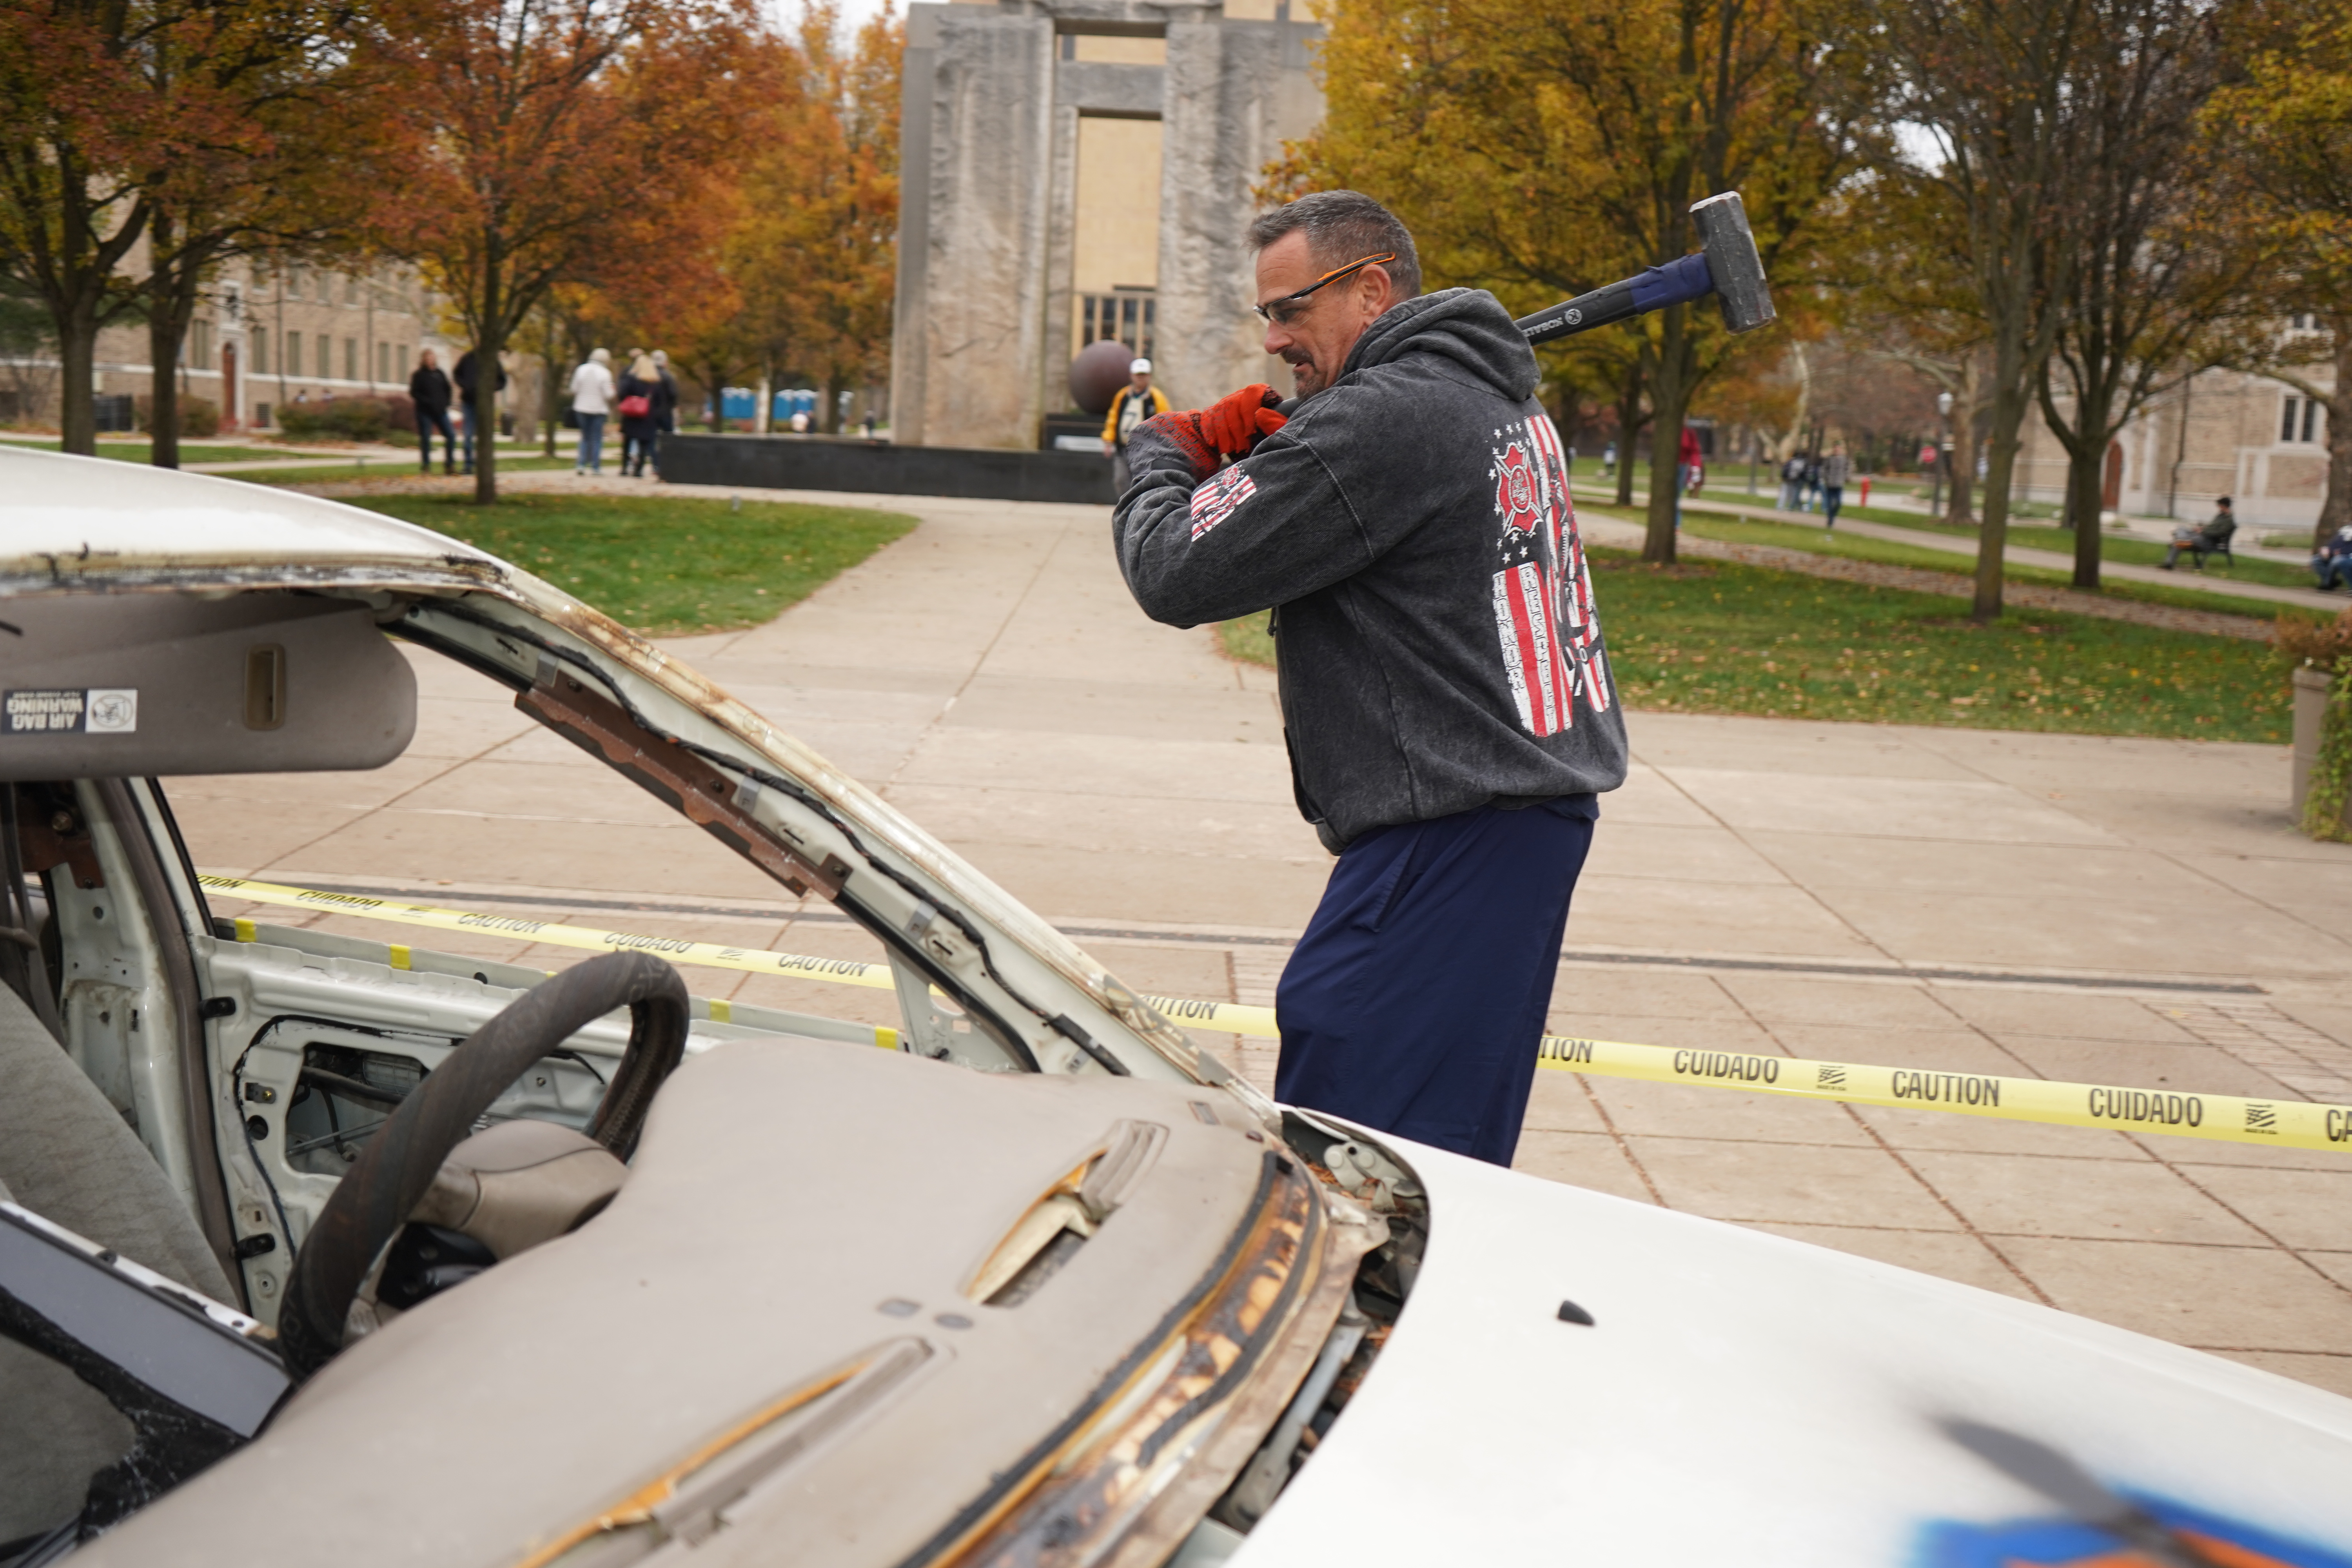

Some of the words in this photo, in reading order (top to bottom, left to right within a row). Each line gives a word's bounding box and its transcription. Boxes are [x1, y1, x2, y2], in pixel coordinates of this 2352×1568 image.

[196, 875, 246, 890] TION
[297, 891, 383, 910] CUIDADO
[458, 913, 547, 933] CAUTION
[605, 932, 695, 953] CUIDADO
[779, 954, 871, 976] CAUTION
[1143, 995, 1220, 1020] UTION
[1540, 1037, 1593, 1063] TION
[1674, 1050, 1779, 1083] CUIDADO
[1893, 1071, 2000, 1107] CAUTION
[2089, 1088, 2202, 1127] CUIDADO
